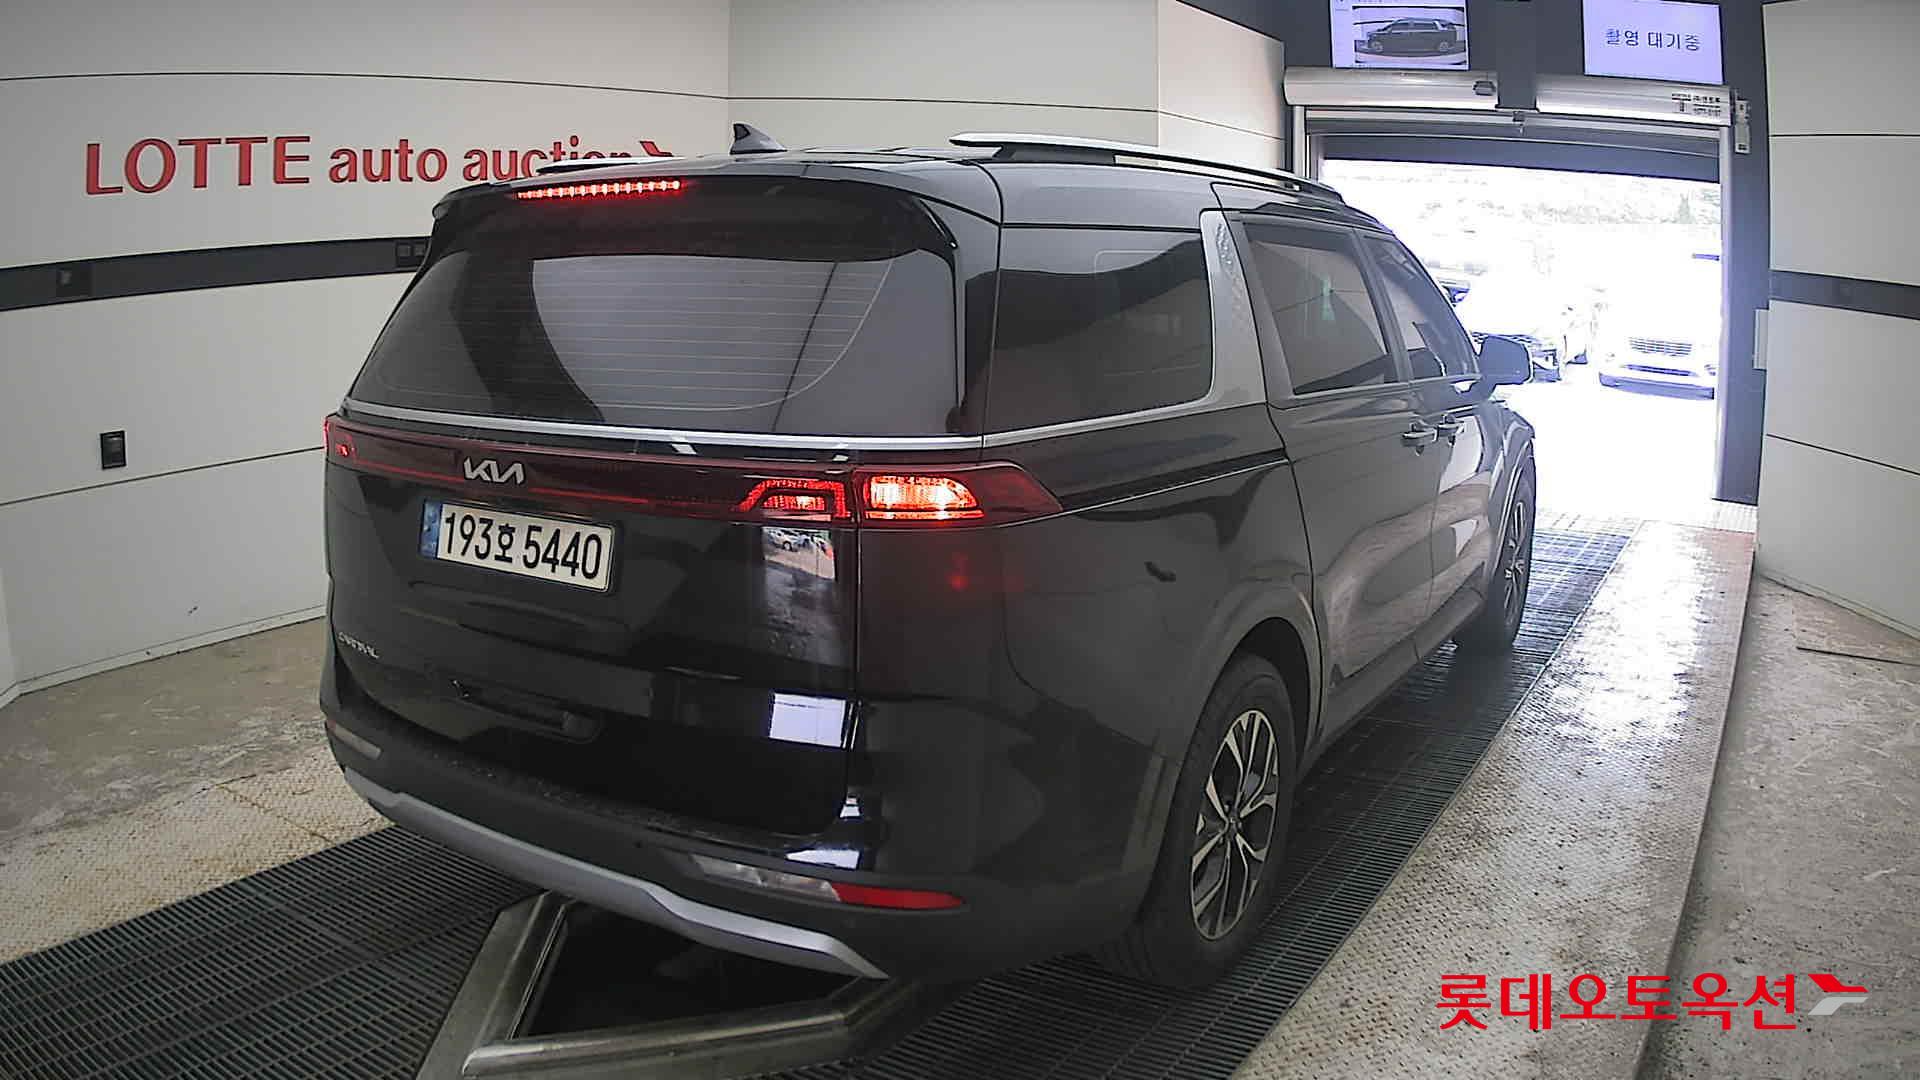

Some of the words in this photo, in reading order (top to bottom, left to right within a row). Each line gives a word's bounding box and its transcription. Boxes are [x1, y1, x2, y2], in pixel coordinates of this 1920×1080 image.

[1646, 31, 1700, 52] 대기중
[86, 135, 311, 195] LOTTE
[328, 138, 449, 184] auto
[444, 511, 517, 564] 193호
[522, 524, 603, 580] 5440
